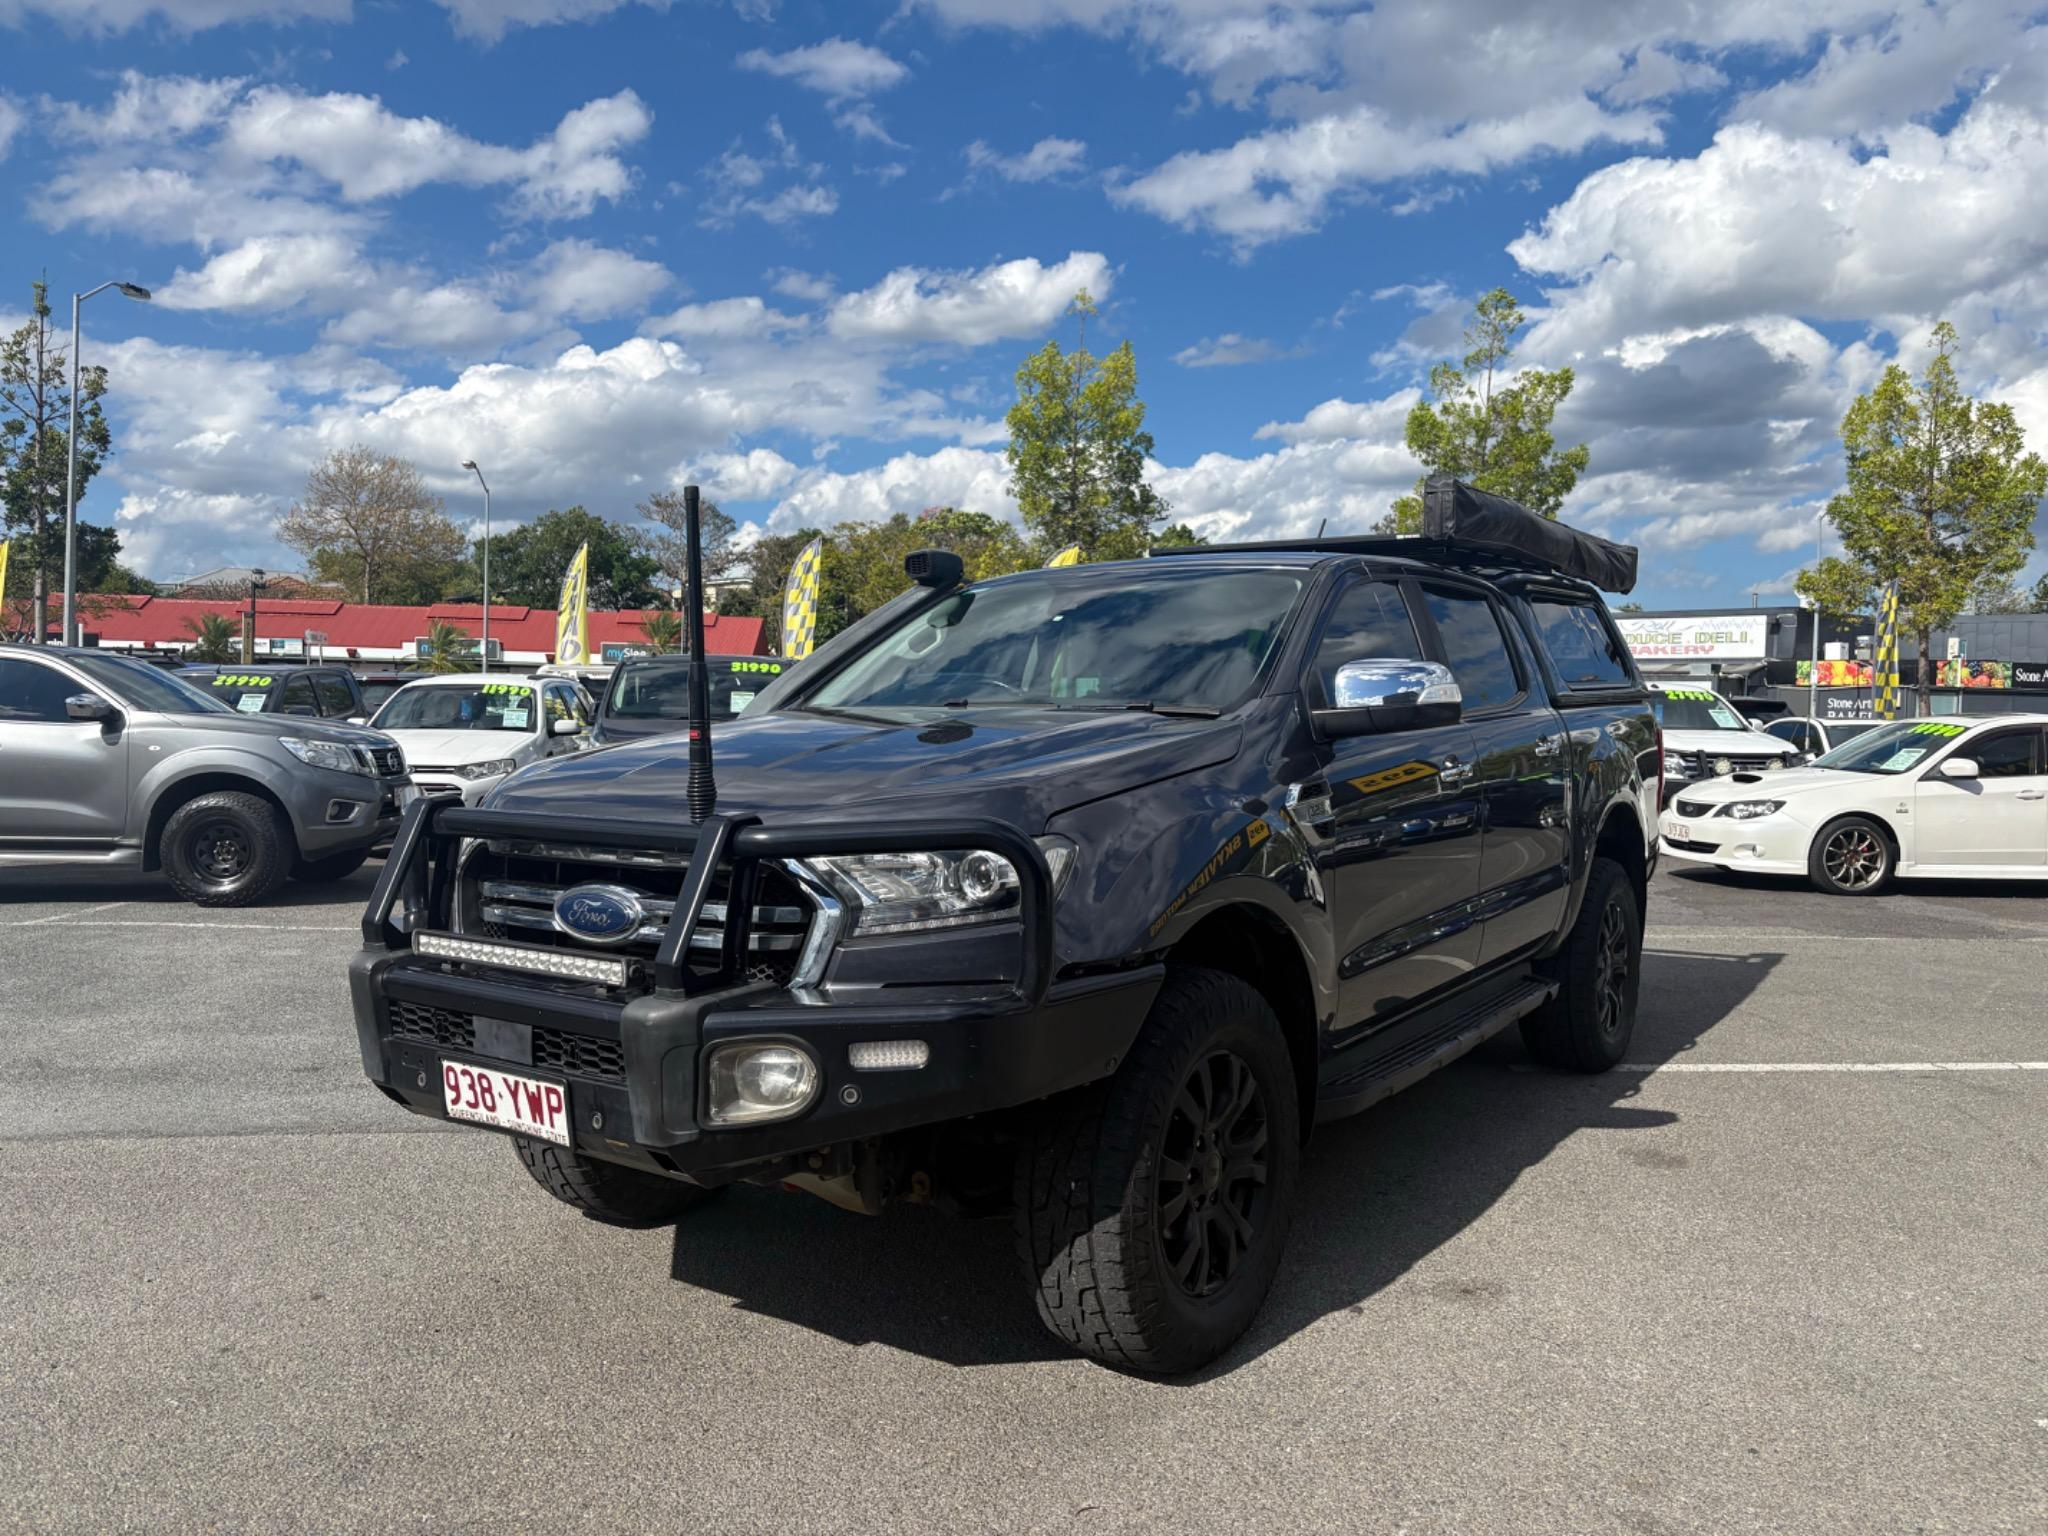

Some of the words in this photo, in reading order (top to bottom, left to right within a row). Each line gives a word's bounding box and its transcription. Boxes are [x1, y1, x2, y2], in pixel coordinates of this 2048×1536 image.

[1624, 632, 1683, 645] DUCE
[1695, 631, 1748, 644] DELI
[211, 674, 272, 687] 29990
[2015, 667, 2041, 682] Stone
[1827, 697, 1854, 709] Stone
[567, 898, 613, 927] Ford
